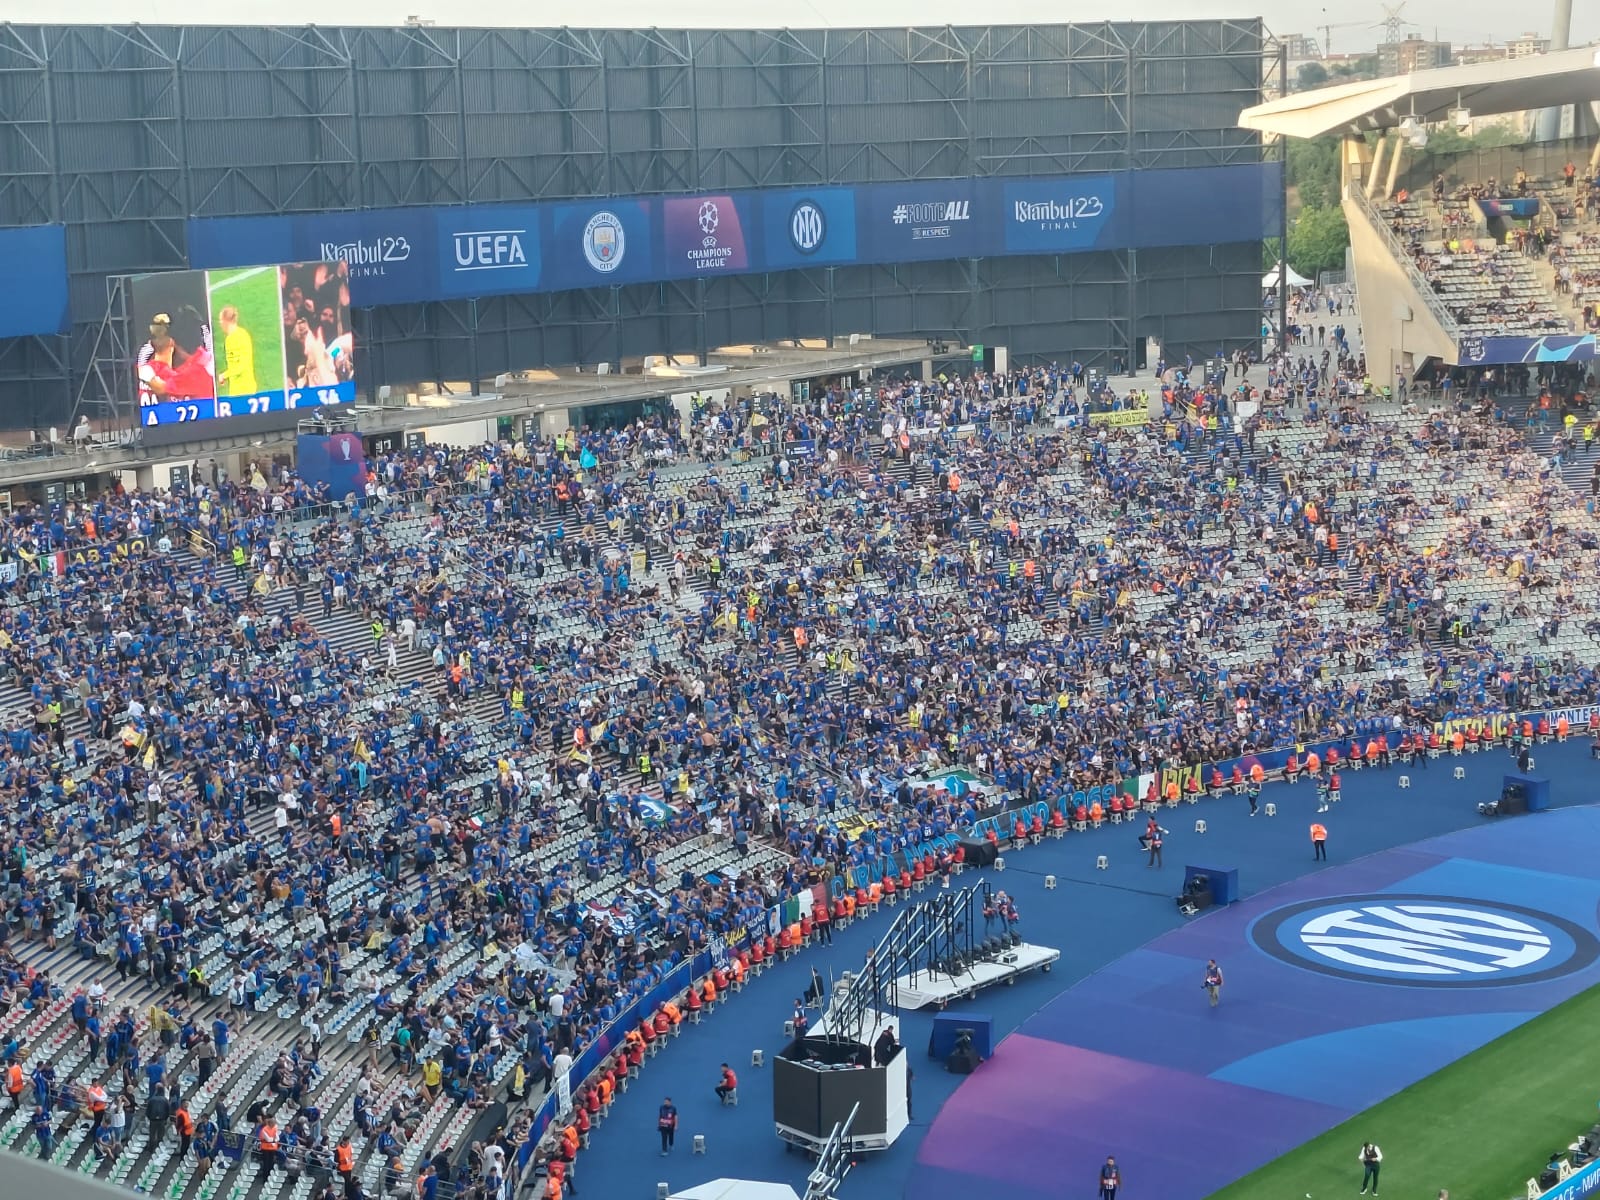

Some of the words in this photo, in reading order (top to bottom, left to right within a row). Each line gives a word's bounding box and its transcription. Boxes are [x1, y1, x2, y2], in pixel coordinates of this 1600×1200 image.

[892, 200, 970, 224] #FOOTBALL
[586, 214, 622, 234] MANCHESTER
[1041, 221, 1078, 231] FINAL
[922, 228, 949, 237] RESPECT
[455, 235, 526, 266] UEFA
[687, 247, 732, 259] CHAMPIONS
[696, 257, 726, 268] LEAGUE
[349, 265, 386, 278] FINAL
[76, 540, 145, 564] ABNO
